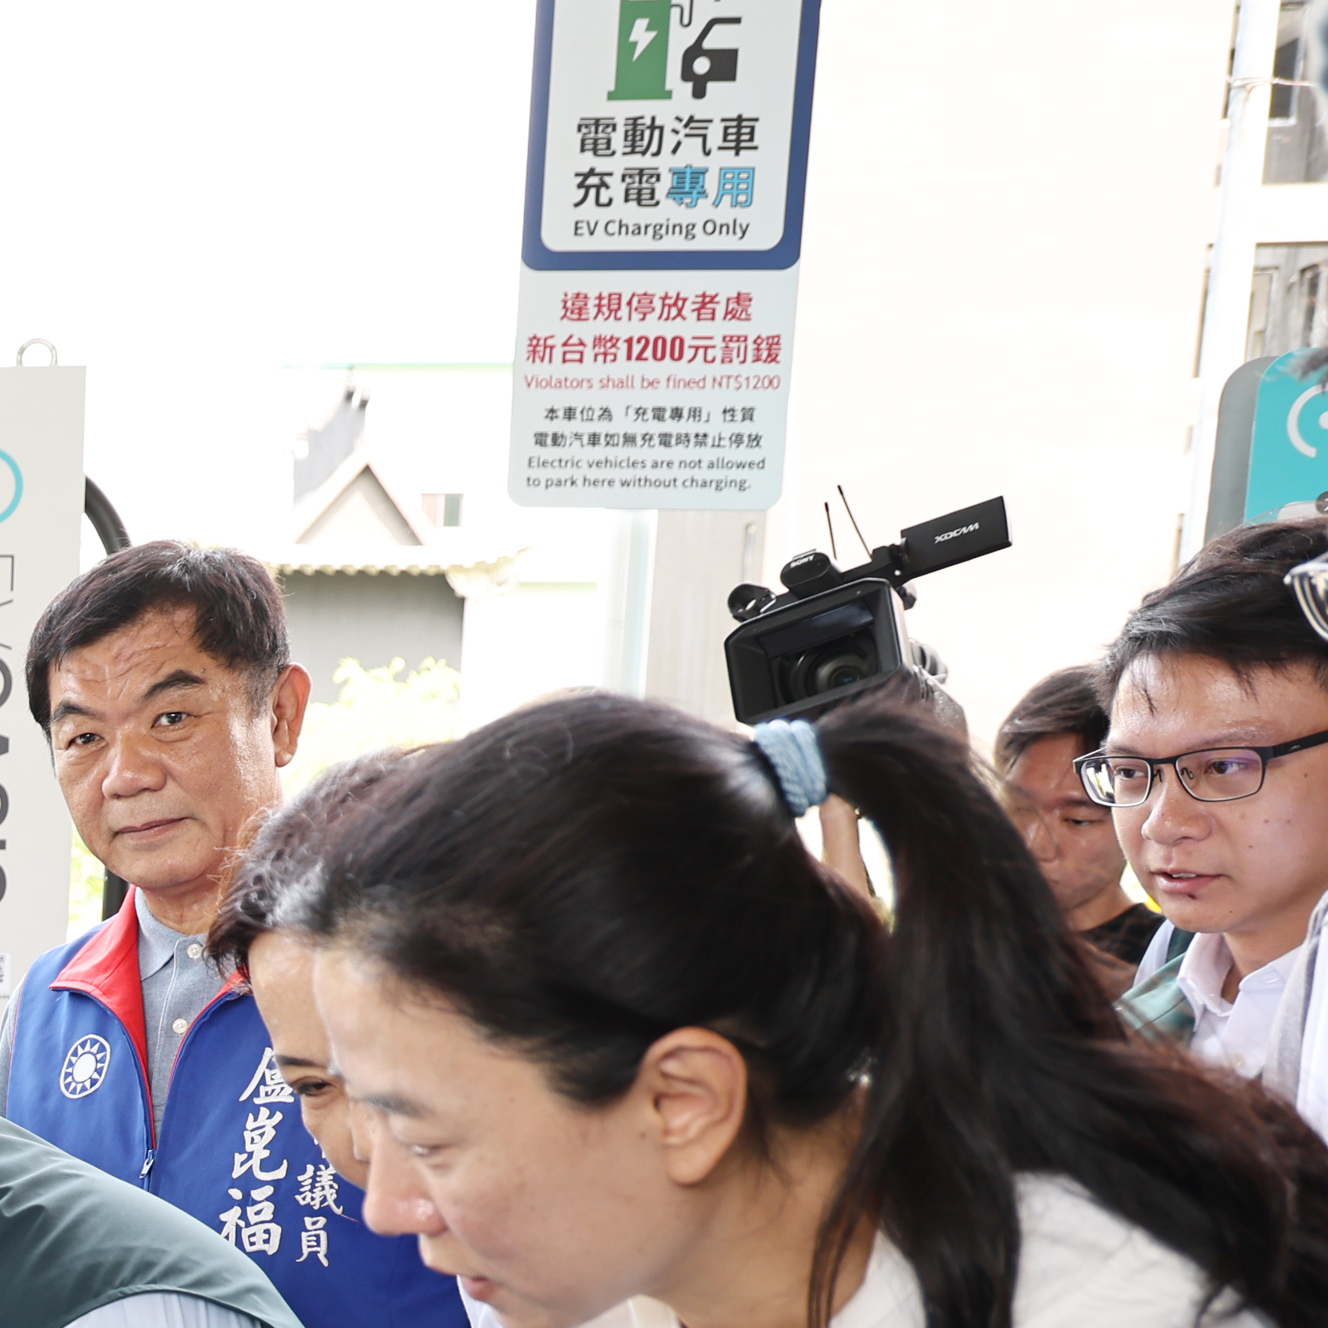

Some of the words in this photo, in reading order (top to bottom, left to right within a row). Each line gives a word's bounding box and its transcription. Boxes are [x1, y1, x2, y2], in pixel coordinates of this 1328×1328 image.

[576, 114, 760, 158] 電動汽車
[573, 165, 756, 209] 充電專用
[573, 219, 599, 237] EV
[604, 218, 696, 241] Charging
[702, 217, 751, 241] Only
[560, 290, 754, 322] 違規停放者處
[526, 333, 783, 365] 新台幣1200元罰鍰
[524, 374, 594, 390] Violators
[598, 374, 635, 390] shall
[640, 374, 660, 390] be
[666, 374, 706, 390] fined
[711, 374, 780, 391] NT$1200
[533, 431, 763, 449] 電動汽車如無充電時禁止停放
[528, 456, 582, 470] Electric
[586, 456, 647, 470] vehicles
[651, 458, 674, 470] are
[678, 458, 702, 470] not
[706, 456, 766, 470] allowed
[526, 476, 541, 488] to
[545, 476, 578, 490] park
[582, 476, 615, 488] here
[619, 476, 678, 488] without
[682, 476, 752, 492] charging.
[934, 522, 980, 544] XDCAM
[790, 555, 815, 568] SONY
[295, 1138, 344, 1268] 議員
